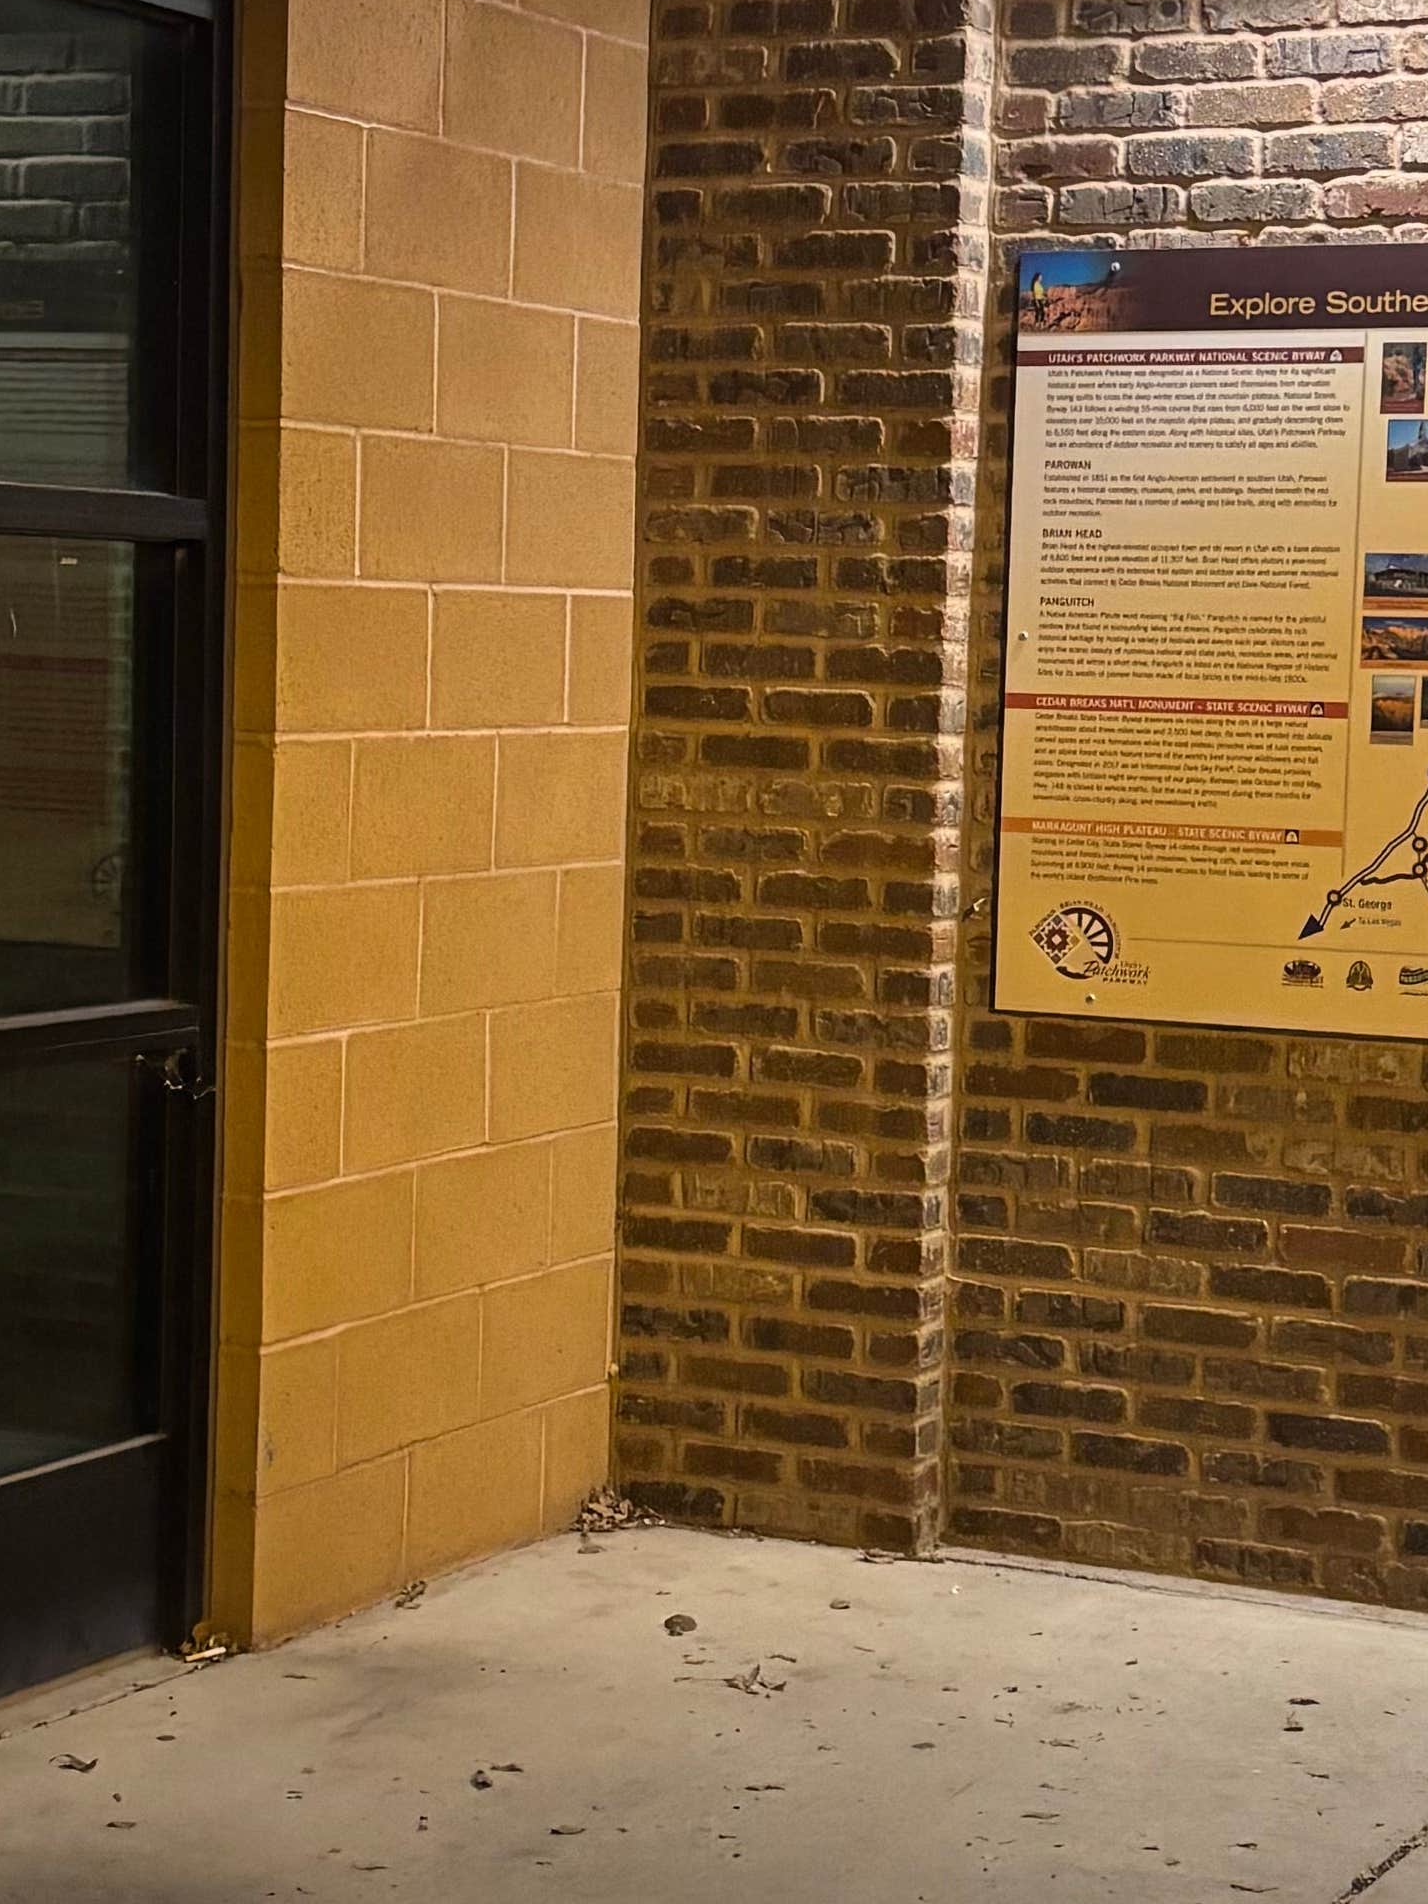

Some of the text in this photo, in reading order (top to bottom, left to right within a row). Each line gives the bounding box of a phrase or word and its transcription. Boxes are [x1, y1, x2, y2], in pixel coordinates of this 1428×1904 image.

[1210, 292, 1316, 320] Explore
[1049, 351, 1325, 364] UTAH'S PATCHWORK PARKWAY NATIONAL SCENIC BYWAY
[1045, 460, 1091, 470] PAROWAN
[1042, 529, 1102, 538] BRIAN HEAD
[1040, 597, 1094, 608] PANGUITCH
[1036, 697, 1066, 707] CEDAR
[1070, 697, 1107, 708] BREAKS
[1109, 699, 1135, 710] NAT'L
[1138, 699, 1194, 711] MONUMENT
[1206, 701, 1234, 713] STATE
[1237, 702, 1272, 713] SCENIC
[1275, 703, 1308, 714] BYWAY
[1032, 821, 1282, 841] MARKAGUNT HIGH PLATEAU STATE SCENIC BYWAY
[1342, 898, 1392, 911] St. George
[1084, 961, 1150, 978] Patchwork
